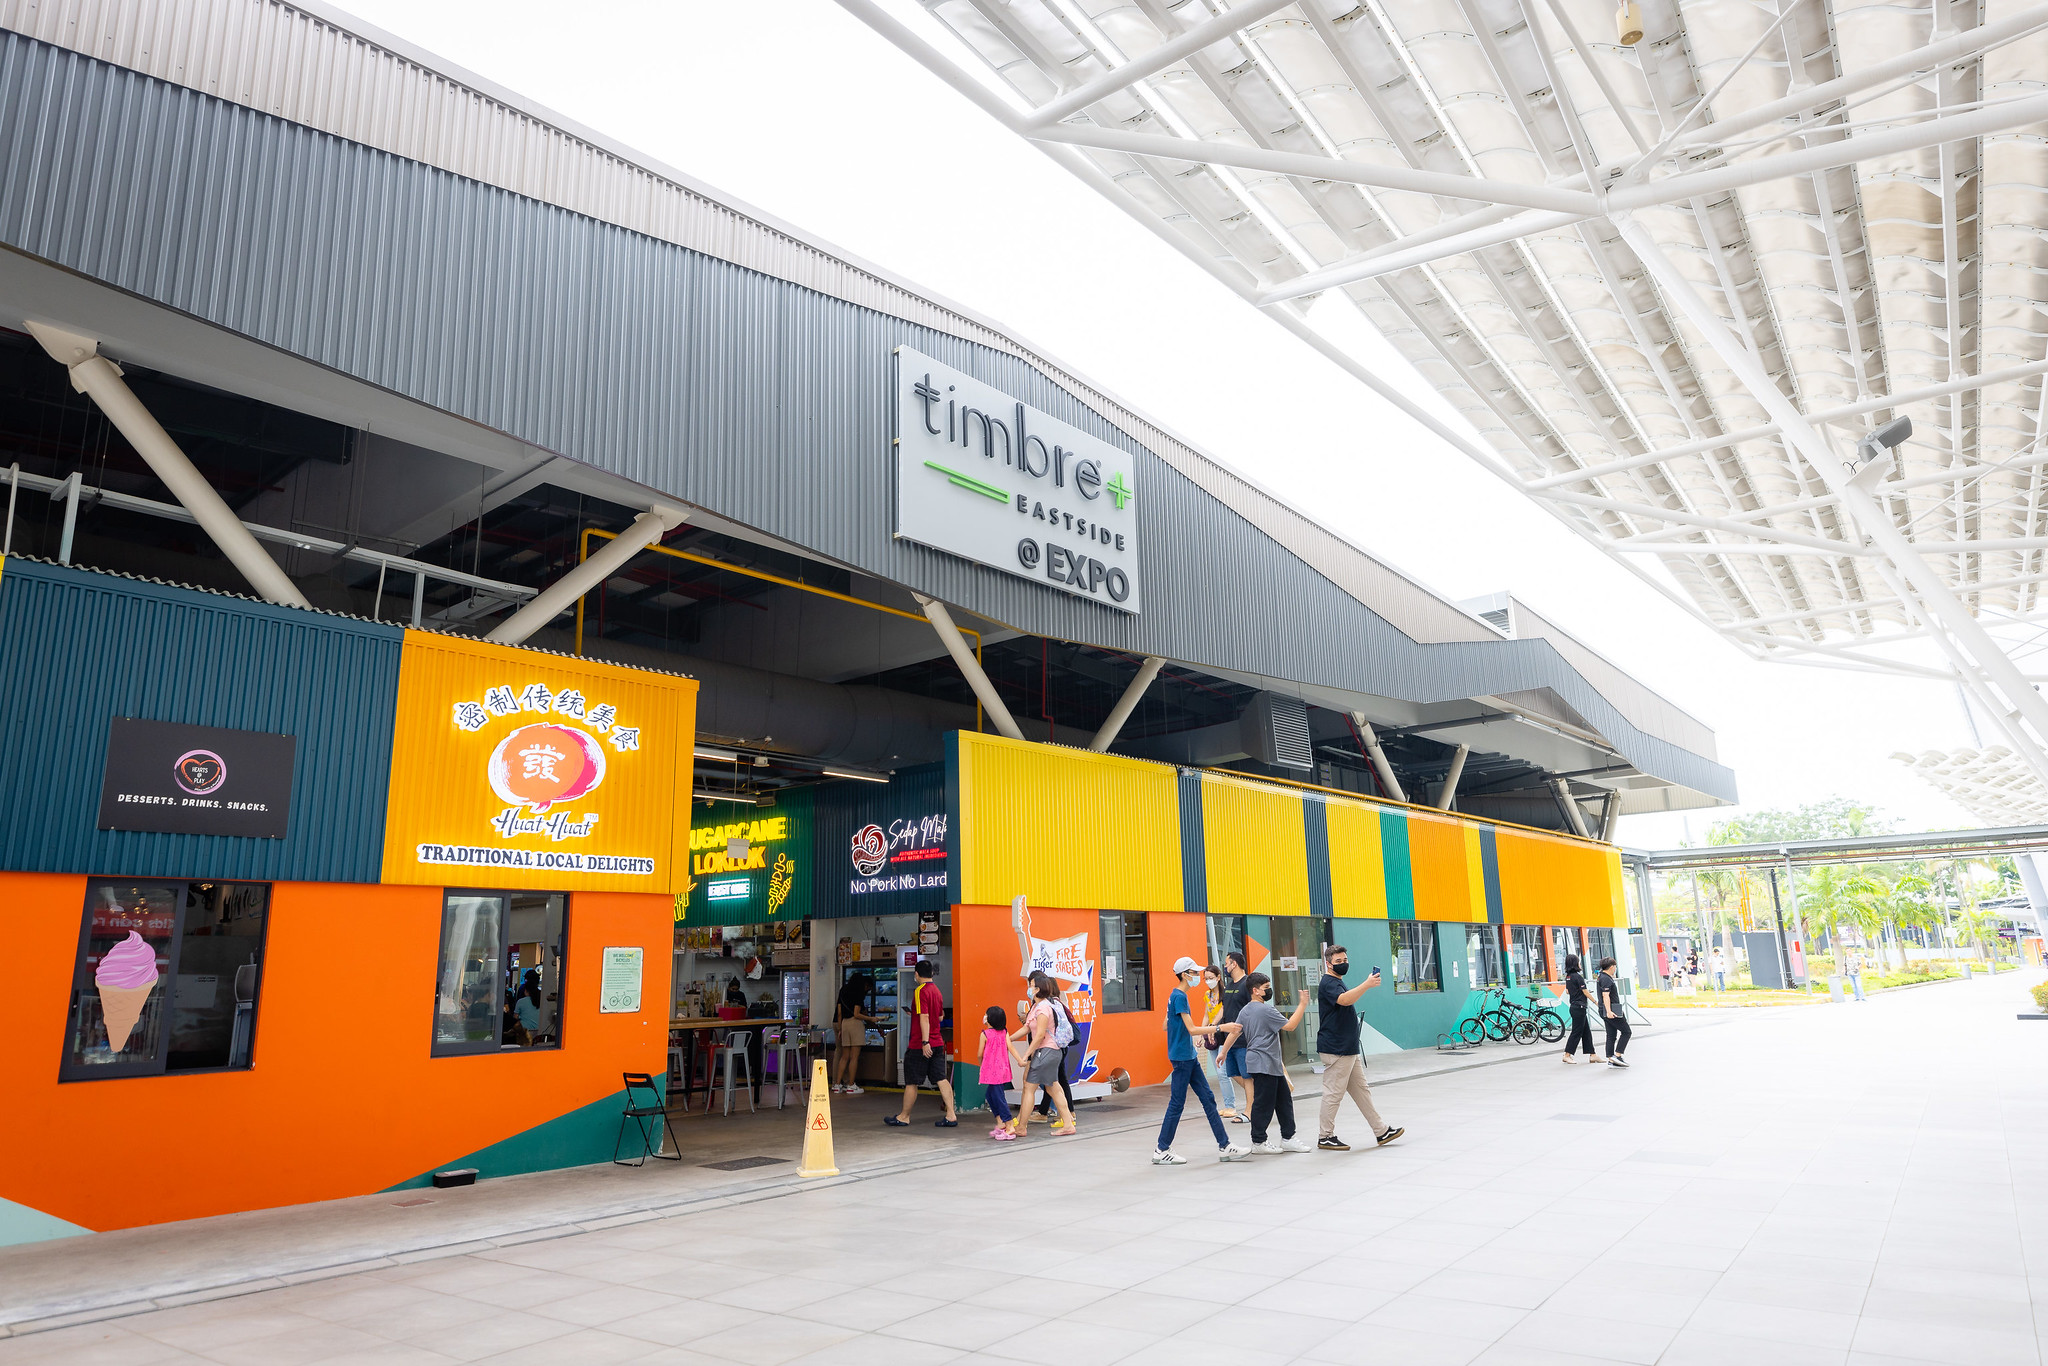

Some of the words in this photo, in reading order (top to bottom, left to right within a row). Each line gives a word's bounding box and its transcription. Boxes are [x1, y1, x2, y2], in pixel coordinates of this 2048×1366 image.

[1016, 493, 1126, 552] EASTSIDE
[191, 766, 209, 774] HEARTS
[117, 793, 178, 806] DESSERTS.
[181, 798, 223, 809] DRINKS.
[226, 801, 269, 812] SNACKS.
[494, 808, 544, 837] Huat
[545, 811, 592, 840] Huat
[689, 816, 787, 851] UGARCANE
[422, 844, 533, 867] TRADITIONAL
[536, 852, 584, 870] LOCAL
[586, 856, 654, 873] DELIGHTS
[850, 880, 867, 894] No
[870, 876, 898, 892] Pork
[899, 875, 916, 890] No
[919, 871, 948, 888] Lard
[1056, 942, 1082, 960] FIRE
[1032, 957, 1054, 973] Tiger
[1055, 959, 1084, 977] STAGES
